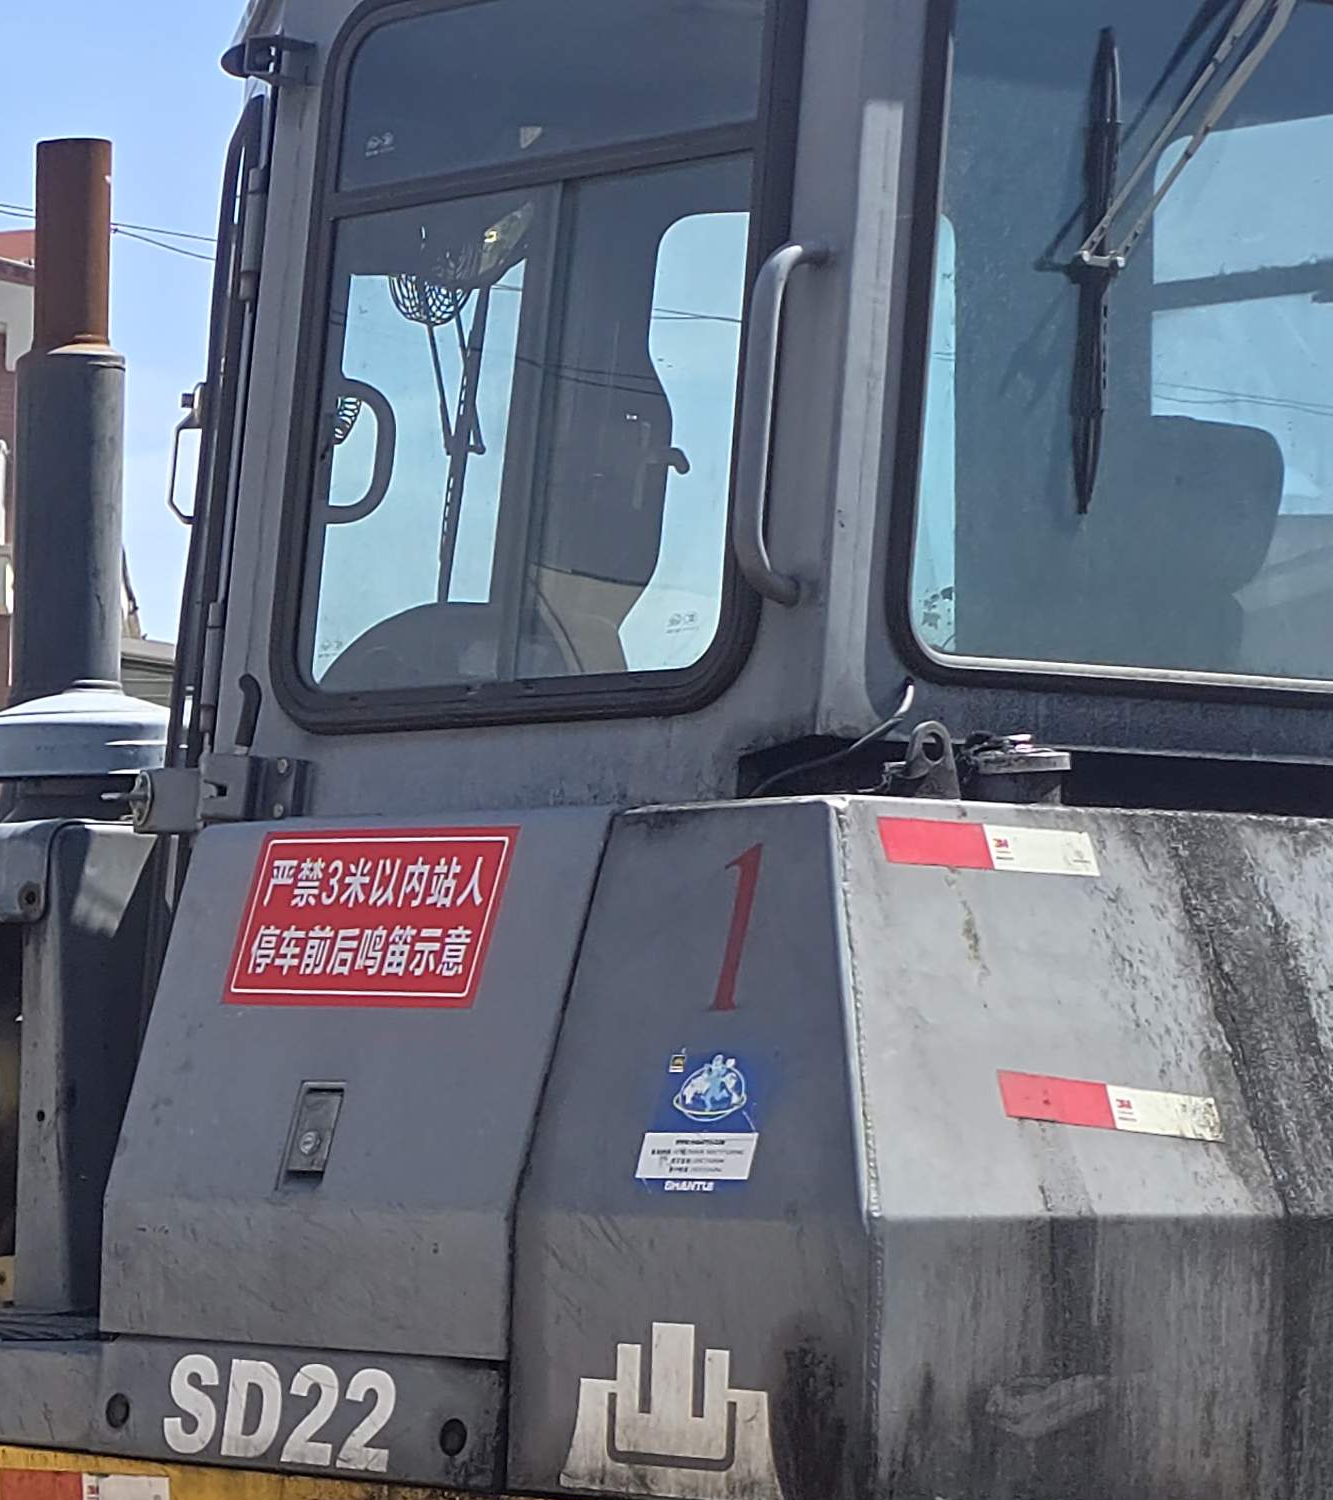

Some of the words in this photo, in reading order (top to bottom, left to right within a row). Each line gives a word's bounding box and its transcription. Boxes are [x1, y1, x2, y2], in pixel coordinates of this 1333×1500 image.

[263, 856, 484, 908] 严禁3米以内站人
[247, 925, 472, 977] 停车前后鸣笛示意
[707, 842, 764, 1012] 1
[163, 1353, 396, 1472] SD22
